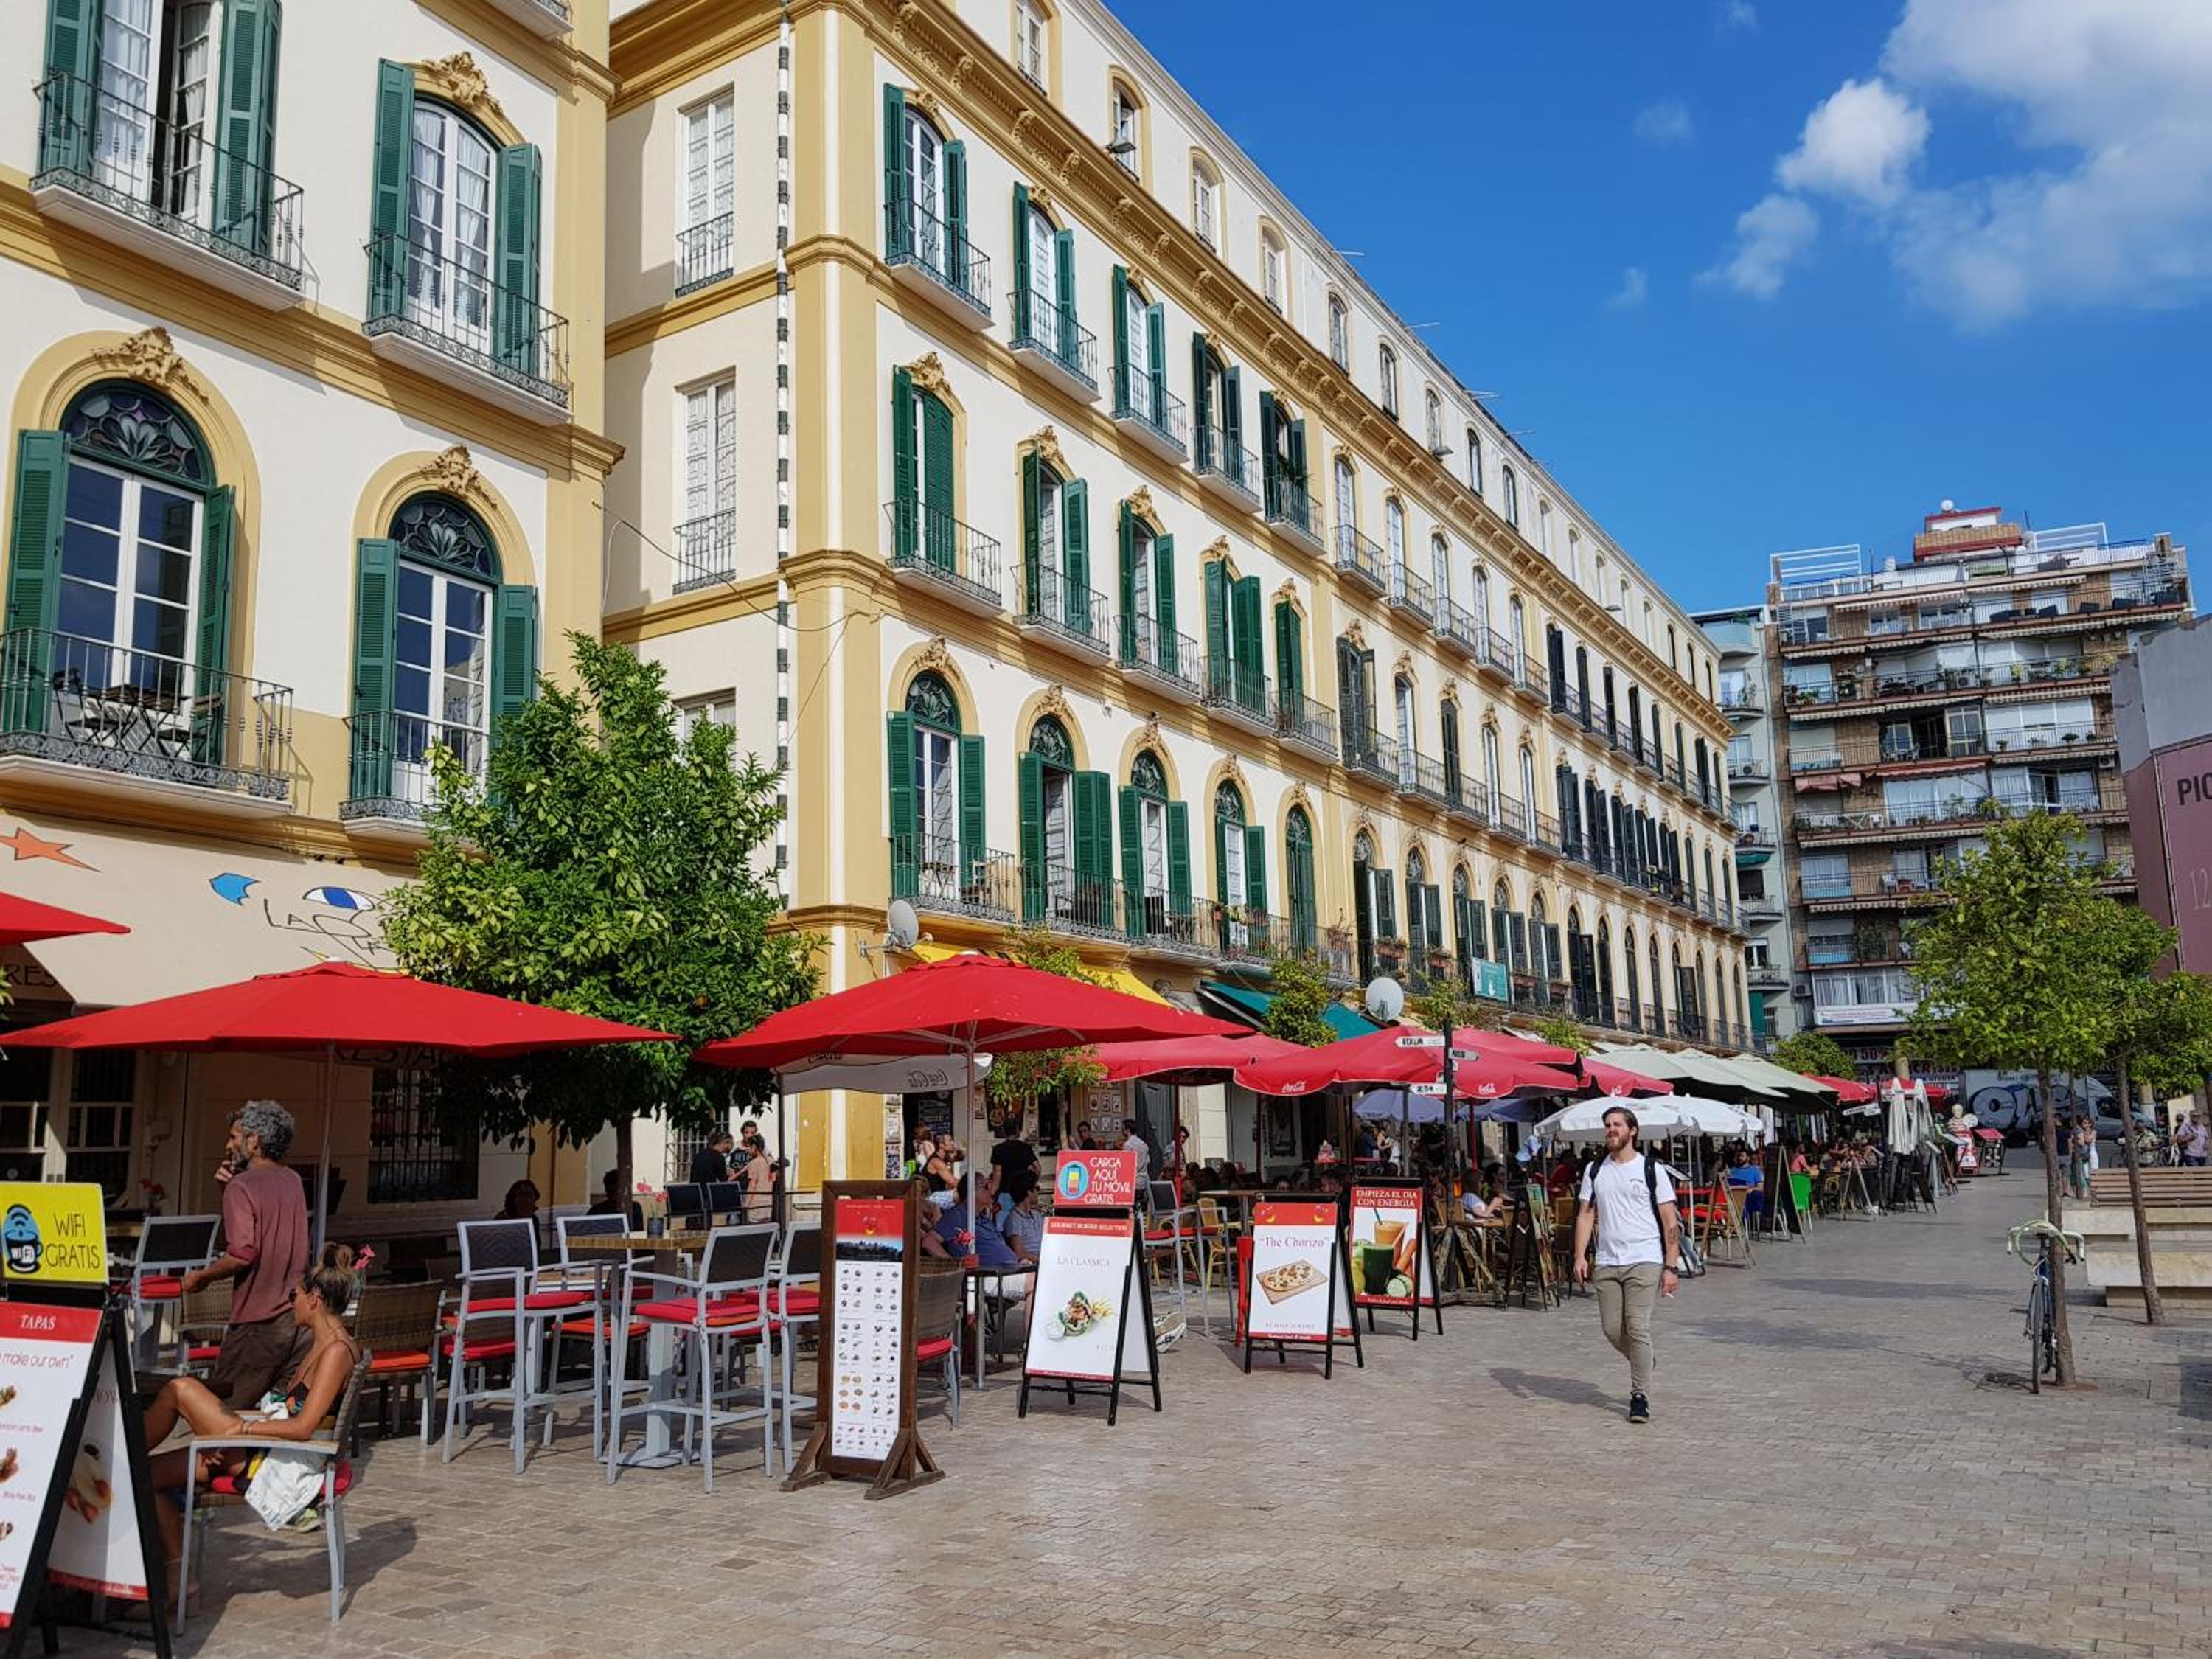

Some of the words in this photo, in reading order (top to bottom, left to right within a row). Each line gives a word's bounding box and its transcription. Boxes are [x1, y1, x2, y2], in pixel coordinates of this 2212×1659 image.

[1090, 1157, 1121, 1167] CARGA
[1091, 1180, 1102, 1192] TU
[1085, 1193, 1114, 1204] GRATIS
[1356, 1189, 1391, 1198] EMPIEZA
[1357, 1198, 1375, 1206] CON
[53, 1213, 86, 1237] WIFI
[45, 1243, 101, 1269] GRATIS
[20, 1315, 57, 1330] TAPAS
